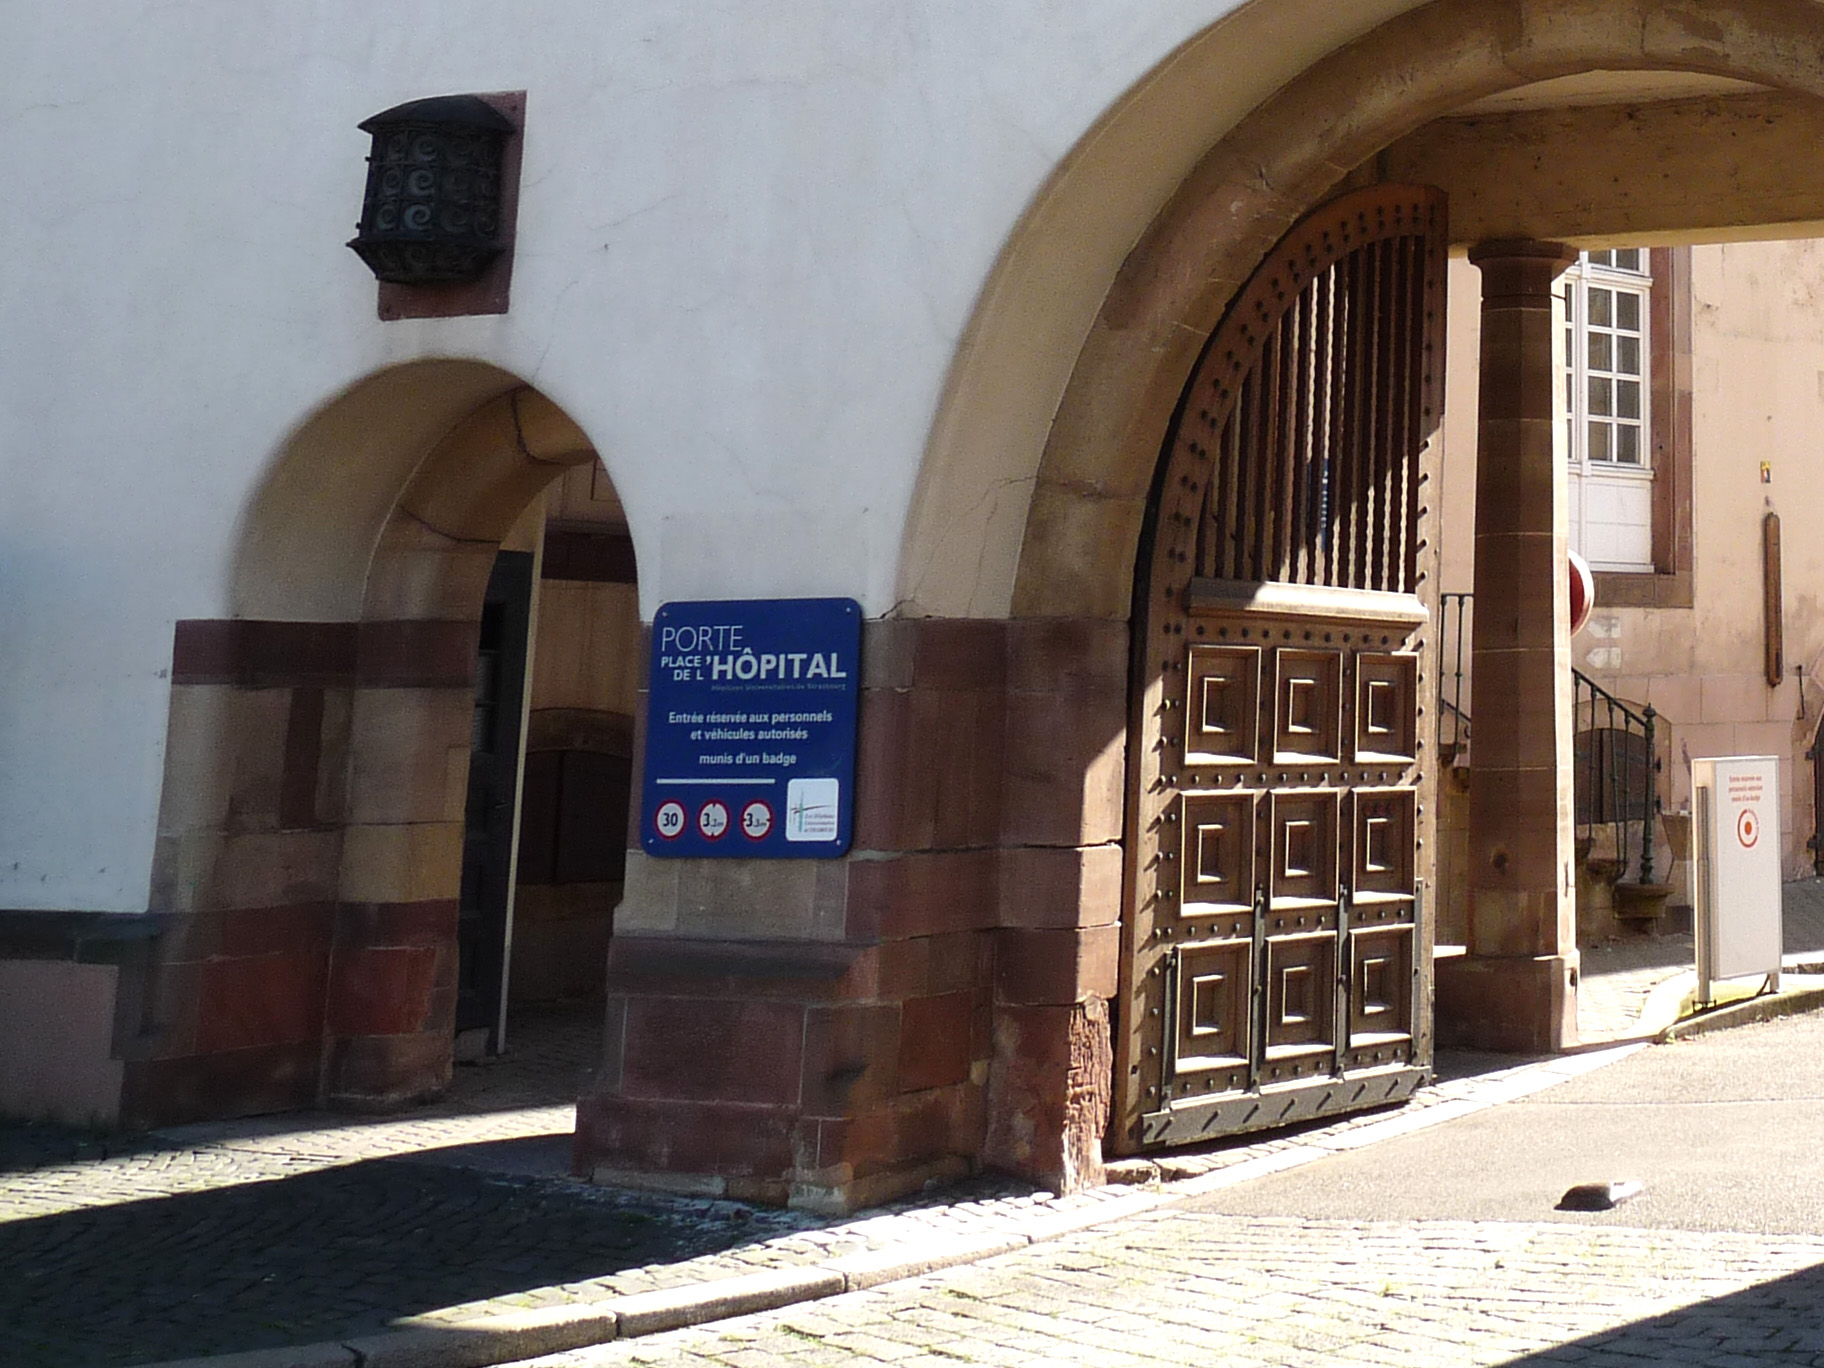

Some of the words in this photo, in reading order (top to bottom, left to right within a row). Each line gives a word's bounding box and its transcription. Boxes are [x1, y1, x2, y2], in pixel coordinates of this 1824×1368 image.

[661, 626, 743, 651] PORTE
[661, 656, 701, 667] PLACE
[674, 670, 690, 680] DE
[669, 712, 704, 723] Entrée
[706, 712, 747, 723] réservée
[749, 713, 769, 722] aux
[772, 710, 832, 724] personnels
[691, 729, 701, 739] et
[704, 728, 755, 739] véhicules
[758, 728, 808, 739] autorisés
[699, 754, 733, 764] munis
[736, 753, 759, 764] d'un
[762, 753, 796, 766] badge
[662, 813, 678, 827] 30
